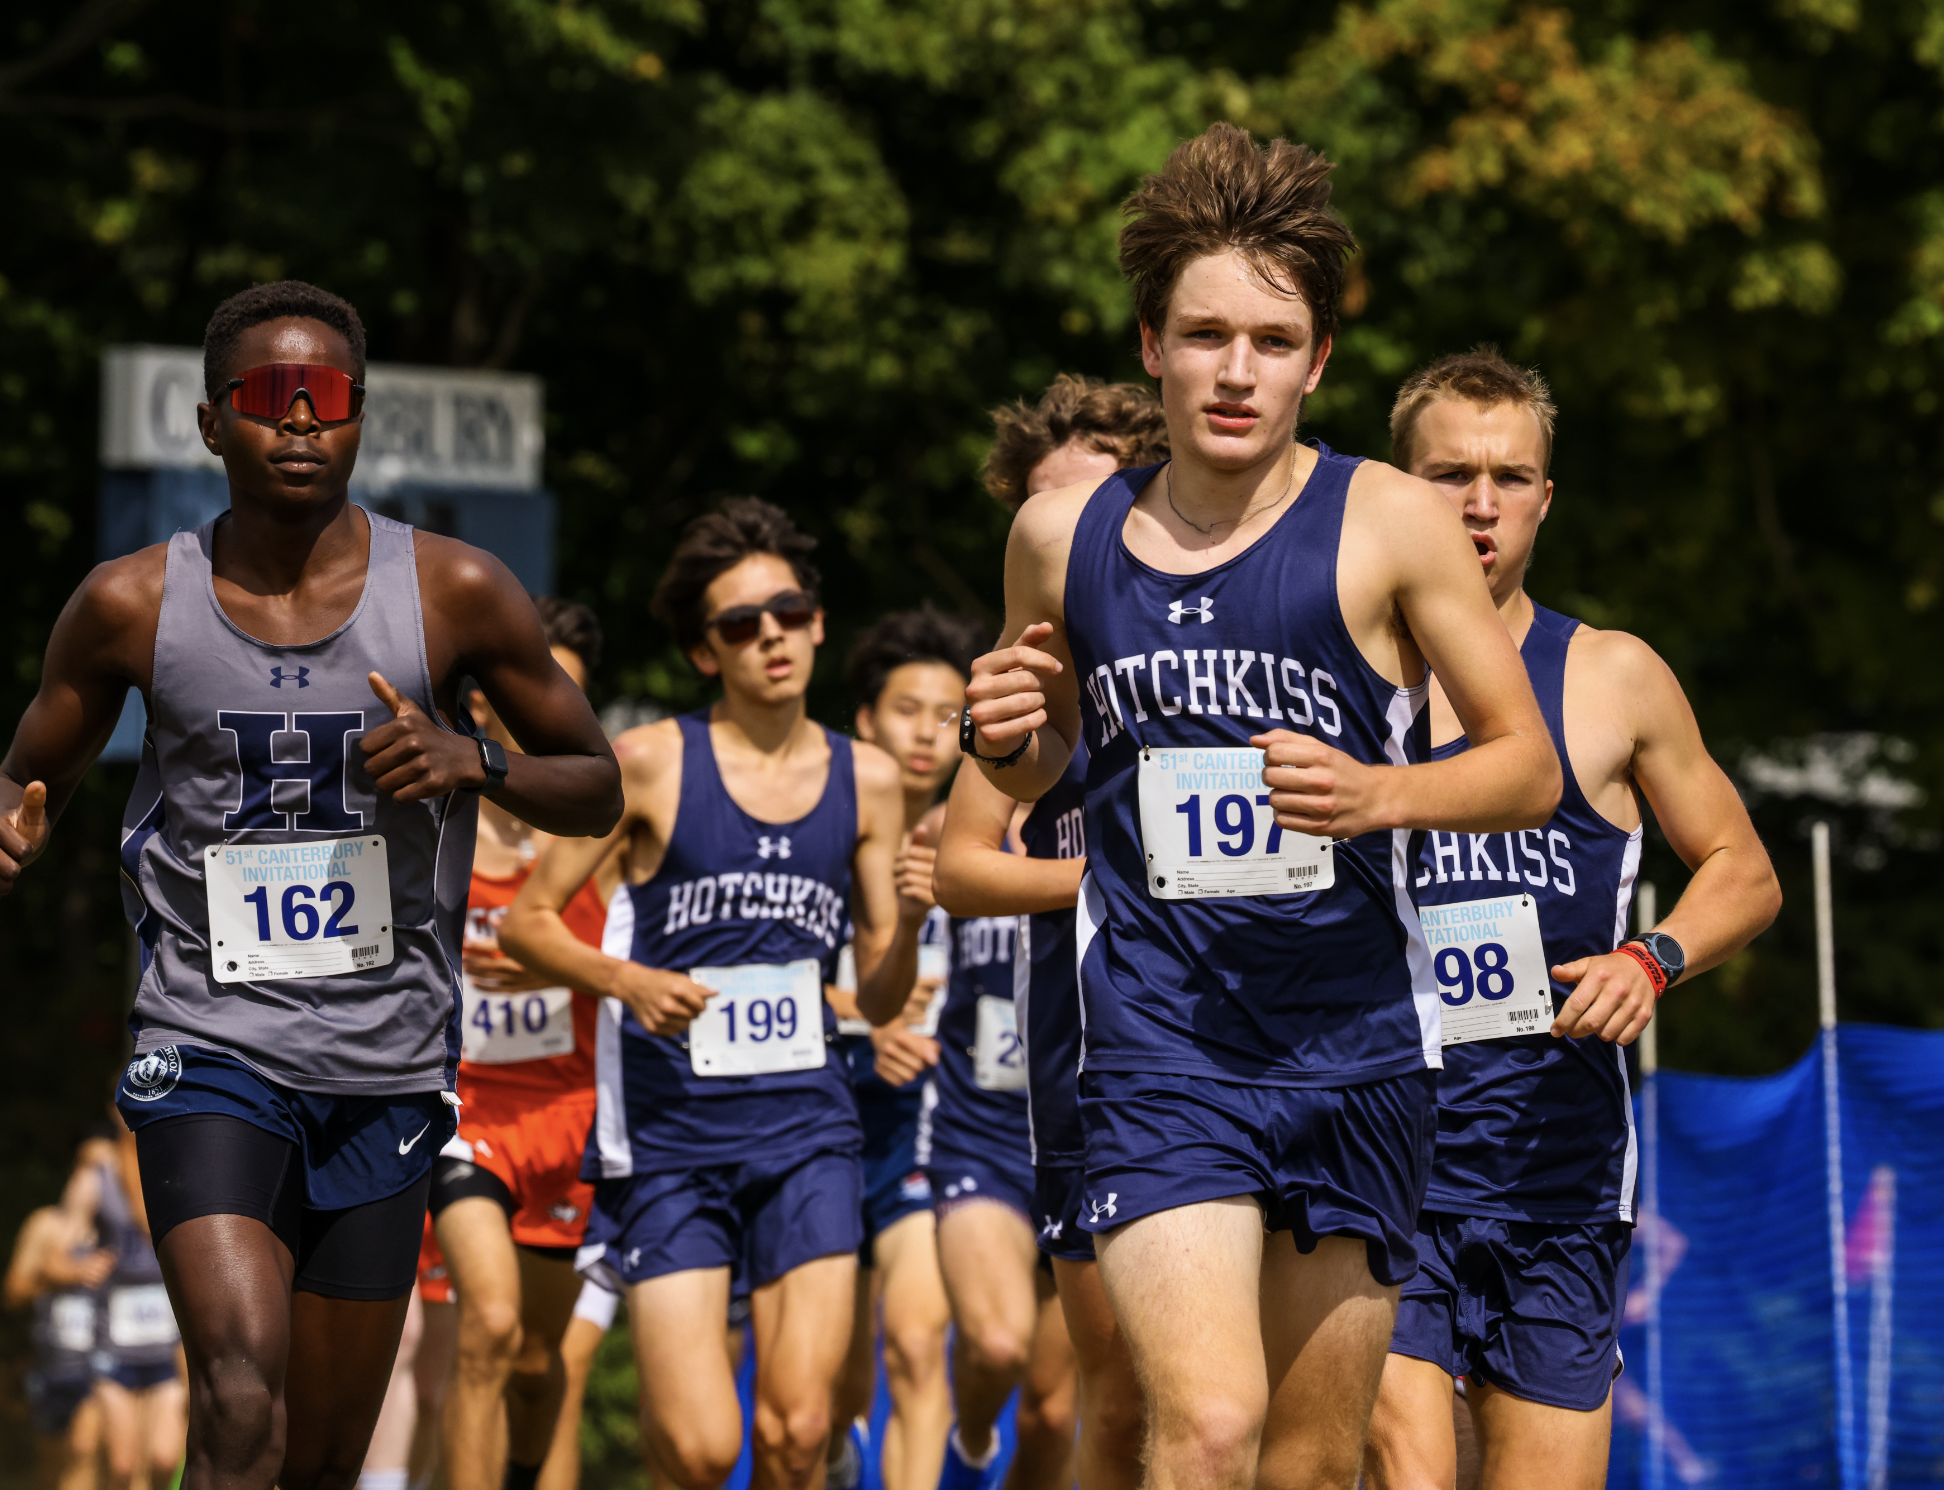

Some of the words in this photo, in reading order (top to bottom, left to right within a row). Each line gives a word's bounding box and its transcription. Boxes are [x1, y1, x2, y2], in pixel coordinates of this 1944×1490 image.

[1087, 650, 1342, 747] HOTCHKISS
[217, 710, 364, 832] H
[1160, 753, 1188, 770] 51st
[1193, 753, 1265, 770] CANTER
[1176, 794, 1284, 857] 197
[225, 849, 254, 865] 51st
[258, 841, 364, 865] CANTERBURY
[242, 861, 352, 882] INVITATIONAL
[1417, 829, 1576, 896] HKISS
[244, 880, 359, 941] 162
[472, 995, 548, 1038] 410
[719, 997, 798, 1043] 199
[998, 1030, 1020, 1070] 2
